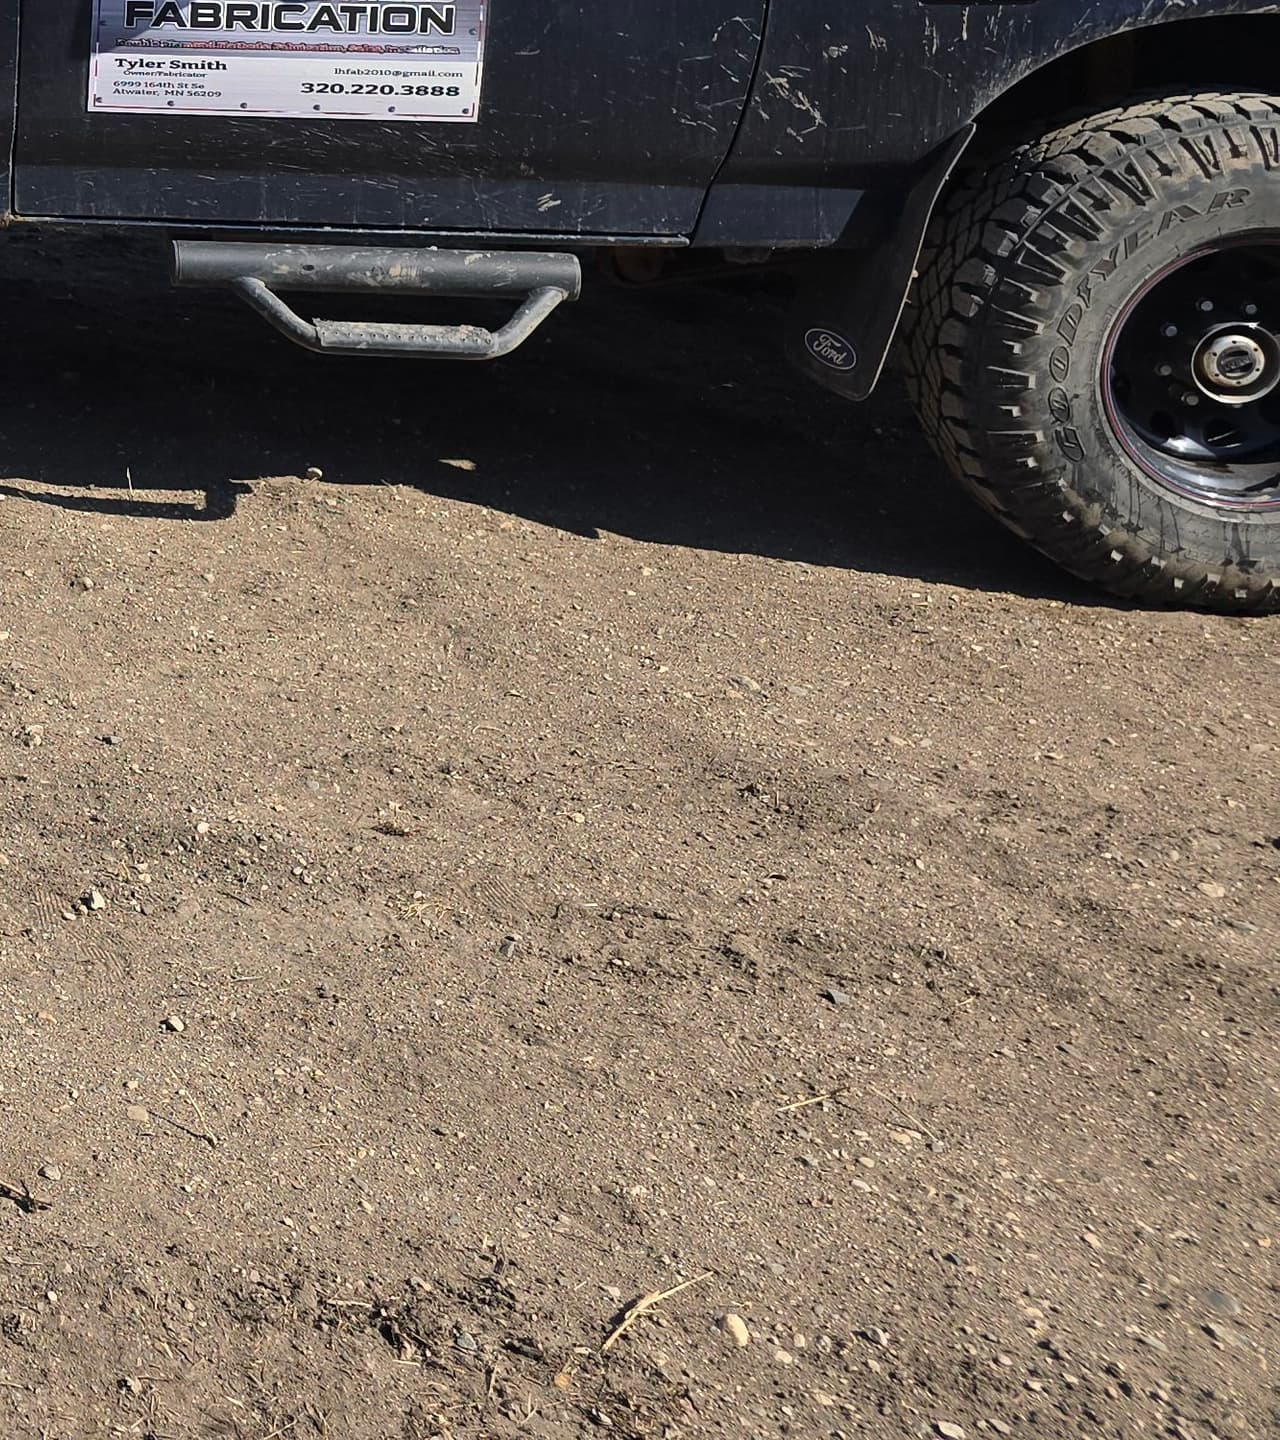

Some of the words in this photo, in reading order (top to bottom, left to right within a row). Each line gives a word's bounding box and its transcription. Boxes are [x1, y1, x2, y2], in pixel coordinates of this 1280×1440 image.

[115, 58, 166, 70] Tyler
[169, 60, 228, 71] Smith
[123, 70, 208, 78] Owner/Fabricator
[144, 81, 175, 89] 164th
[300, 82, 460, 97] 320.220.3888
[112, 88, 161, 97] Atwater,
[186, 90, 222, 98] 56209
[1047, 188, 1251, 463] GOODYEAR
[812, 333, 848, 365] Ford
